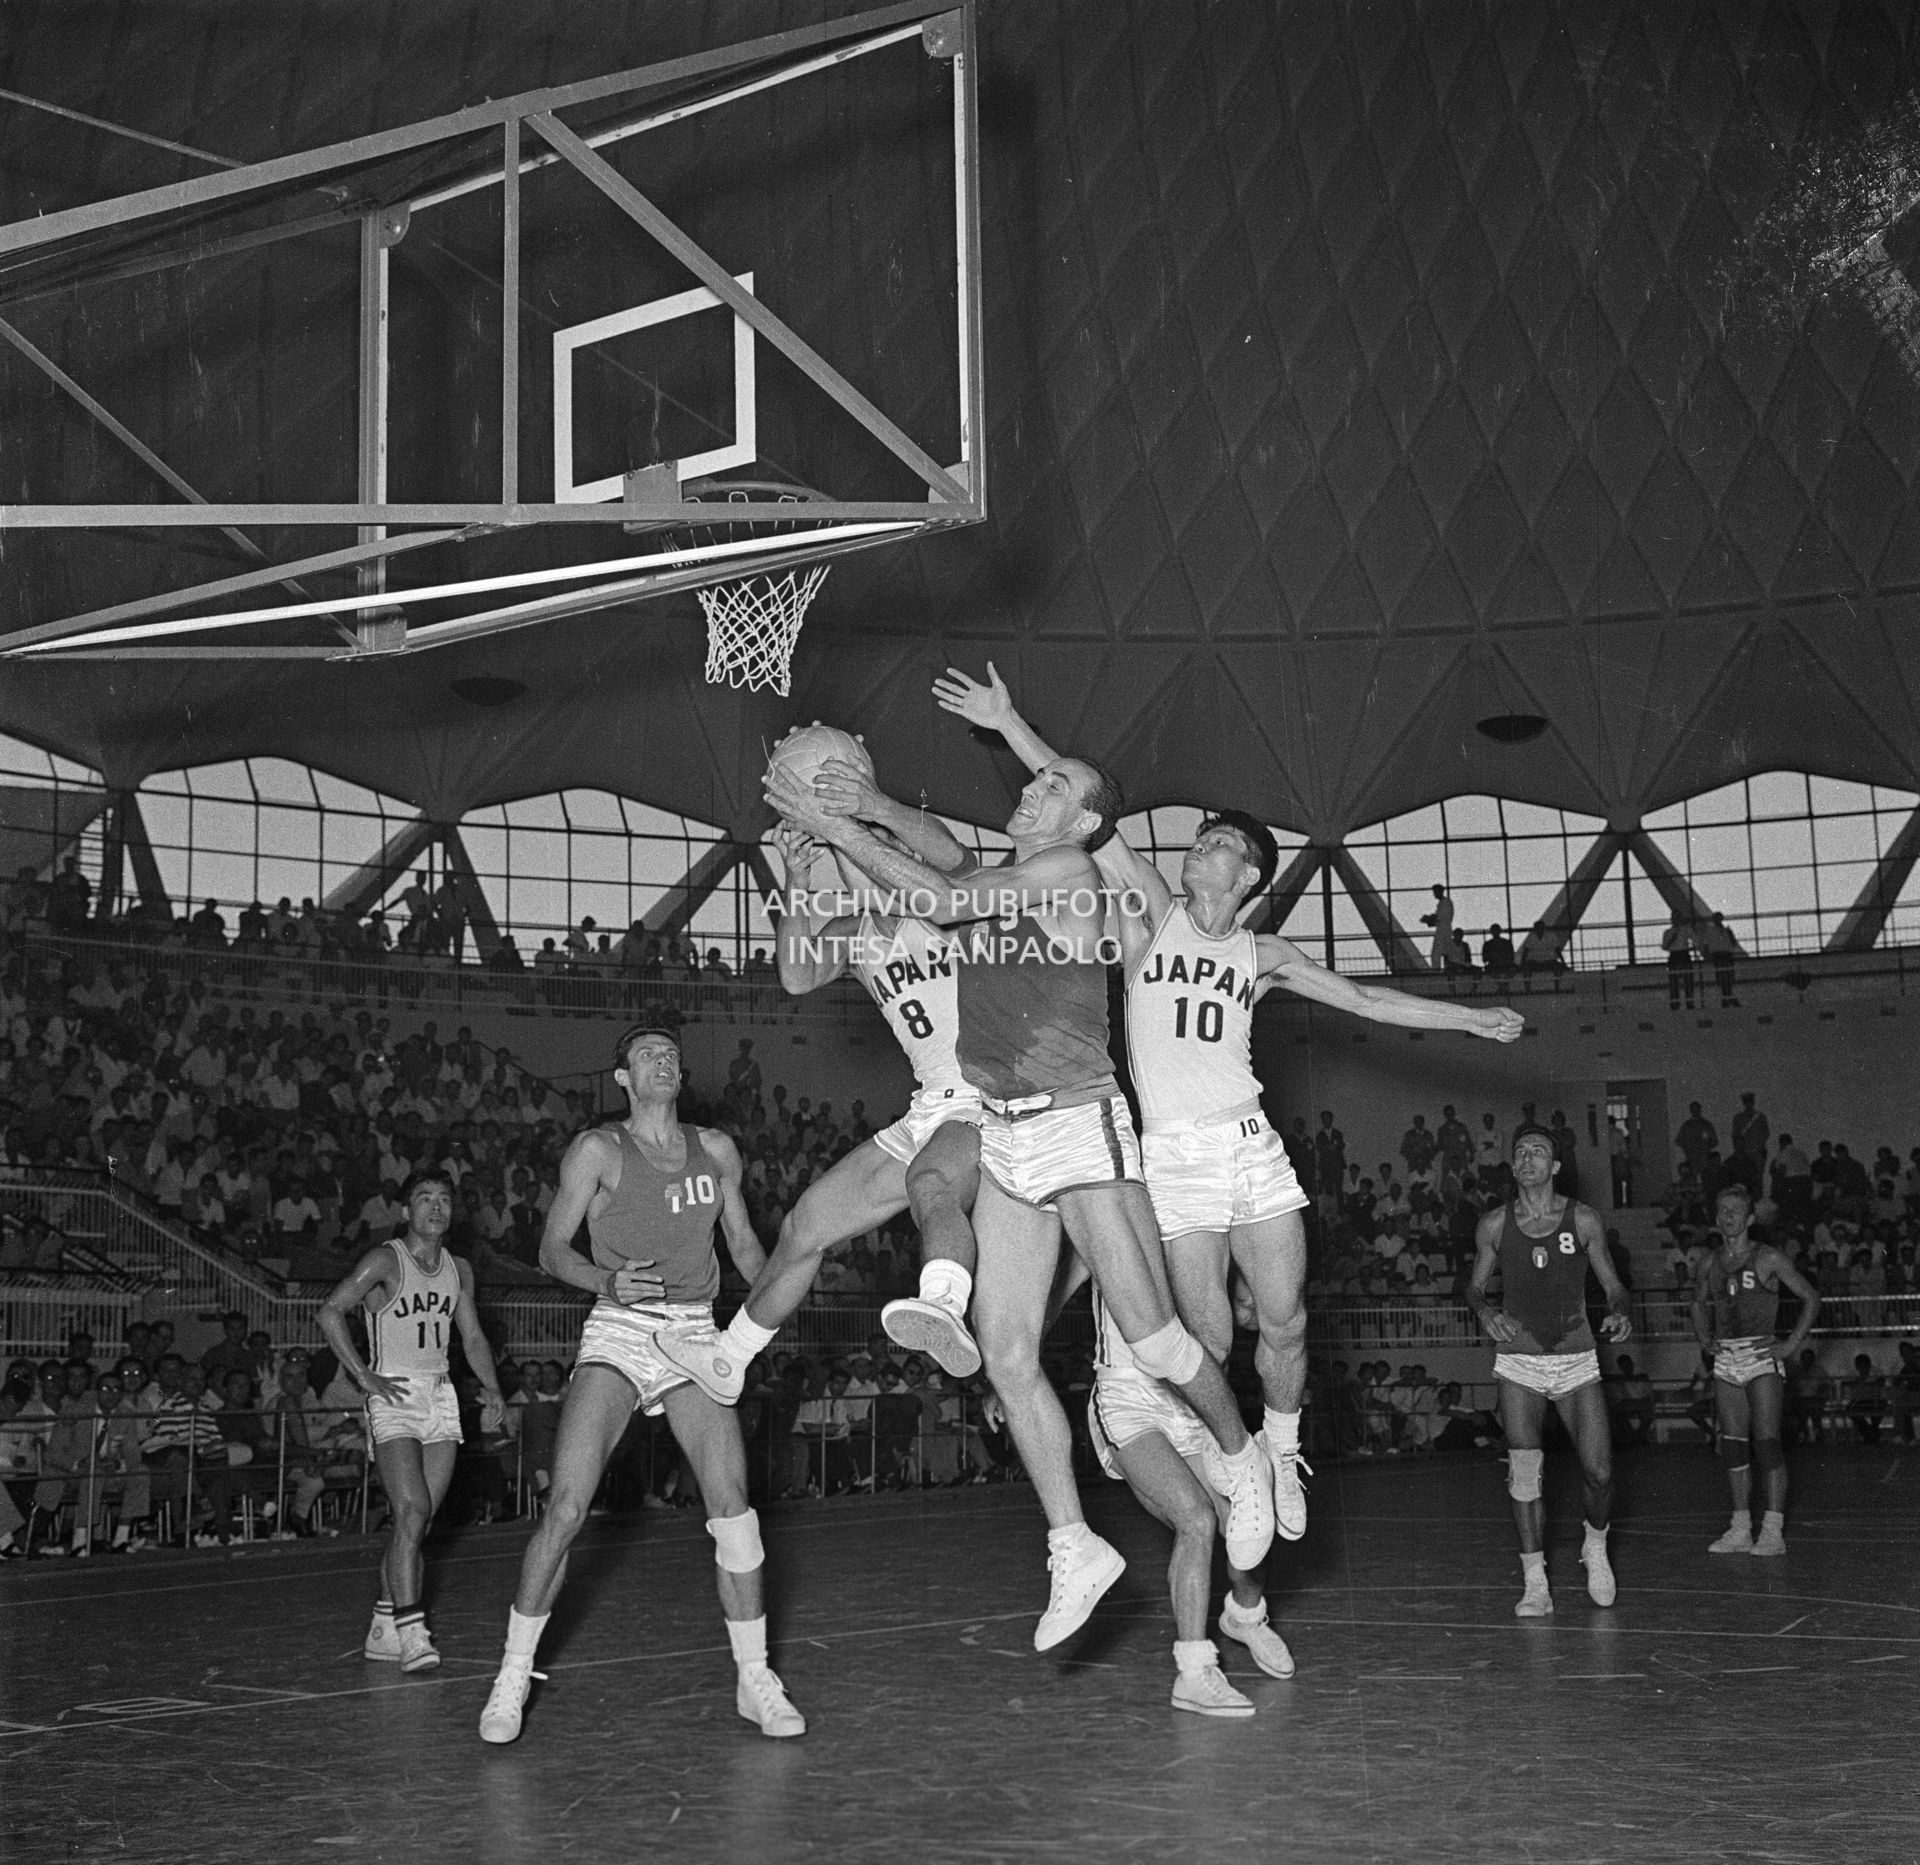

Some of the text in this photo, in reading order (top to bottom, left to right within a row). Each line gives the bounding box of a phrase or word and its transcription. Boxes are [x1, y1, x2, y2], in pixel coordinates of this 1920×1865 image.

[873, 946, 952, 1006] APAN
[1143, 953, 1255, 1011] JAPAN
[899, 999, 934, 1039] 8
[1175, 997, 1224, 1043] 10
[1240, 1118, 1260, 1138] 10
[685, 1175, 715, 1205] 10
[1559, 1232, 1576, 1255] 8
[1742, 1271, 1755, 1289] 5
[393, 1291, 455, 1319] JAPA
[417, 1321, 441, 1349] 11
